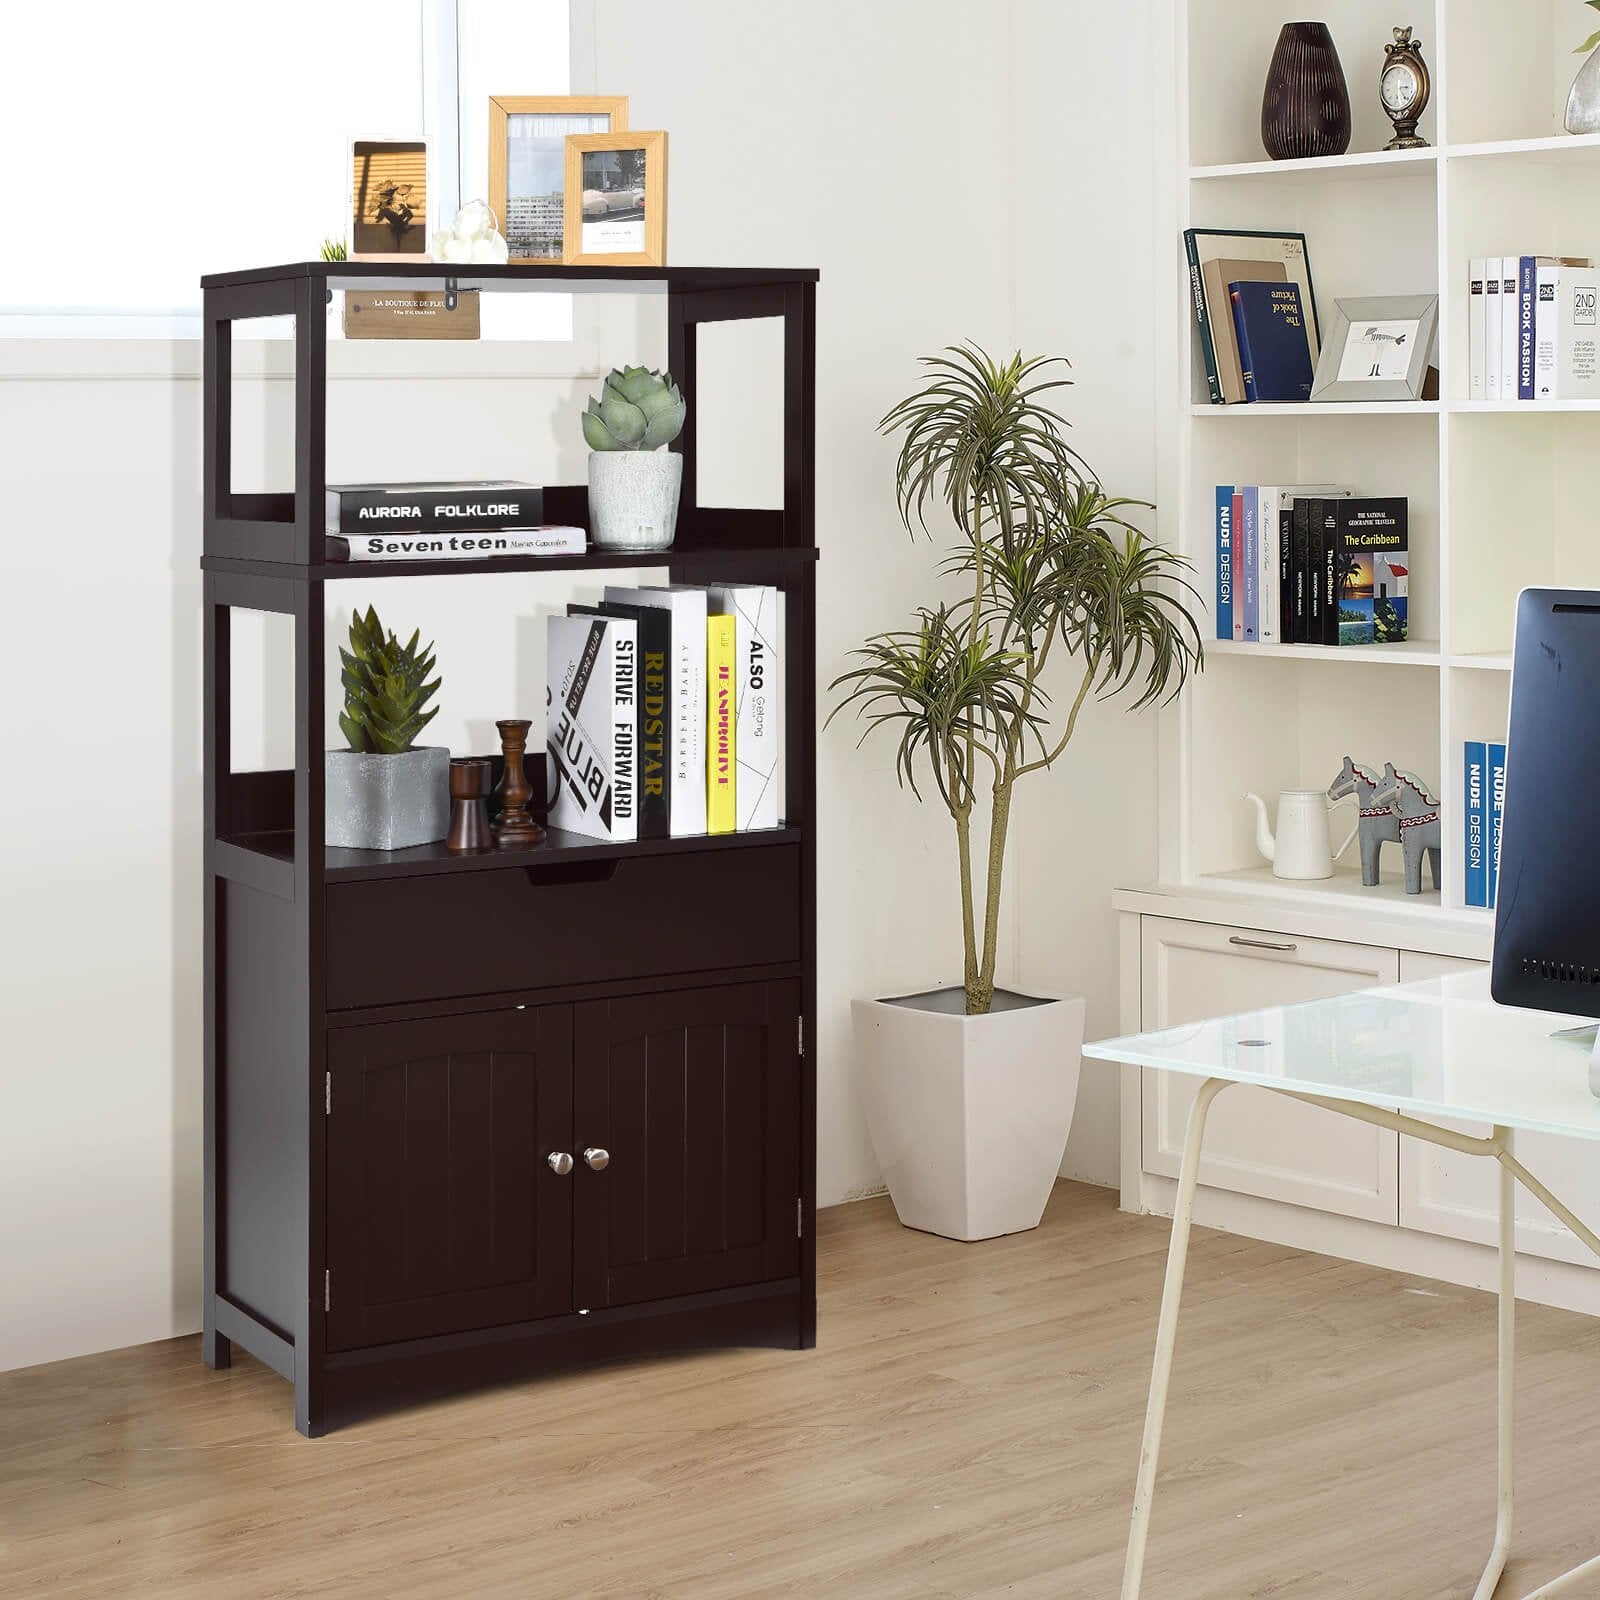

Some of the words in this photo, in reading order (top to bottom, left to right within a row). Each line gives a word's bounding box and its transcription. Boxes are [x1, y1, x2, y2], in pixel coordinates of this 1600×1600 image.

[1271, 290, 1296, 301] Picture
[1281, 303, 1298, 314] Book
[1522, 293, 1531, 329] BOOK
[1575, 294, 1596, 308] 2ND
[1575, 308, 1596, 317] GARDEN
[1286, 317, 1300, 326] The
[1522, 332, 1530, 387] PASSION
[358, 506, 422, 519] AURORA
[434, 504, 520, 517] FOLKLORE
[1220, 506, 1230, 548] NUDE
[1344, 535, 1360, 546] The
[1360, 533, 1400, 546] Caribbean
[1220, 553, 1231, 604] DESIGN
[615, 640, 634, 706] STRIVE
[750, 640, 764, 690] ALSO
[644, 651, 665, 796] REDSTAR
[614, 723, 633, 818] FORWARD
[1470, 764, 1481, 809] NUDE
[1493, 766, 1505, 812] NUDE
[1470, 815, 1481, 869] DESIGN
